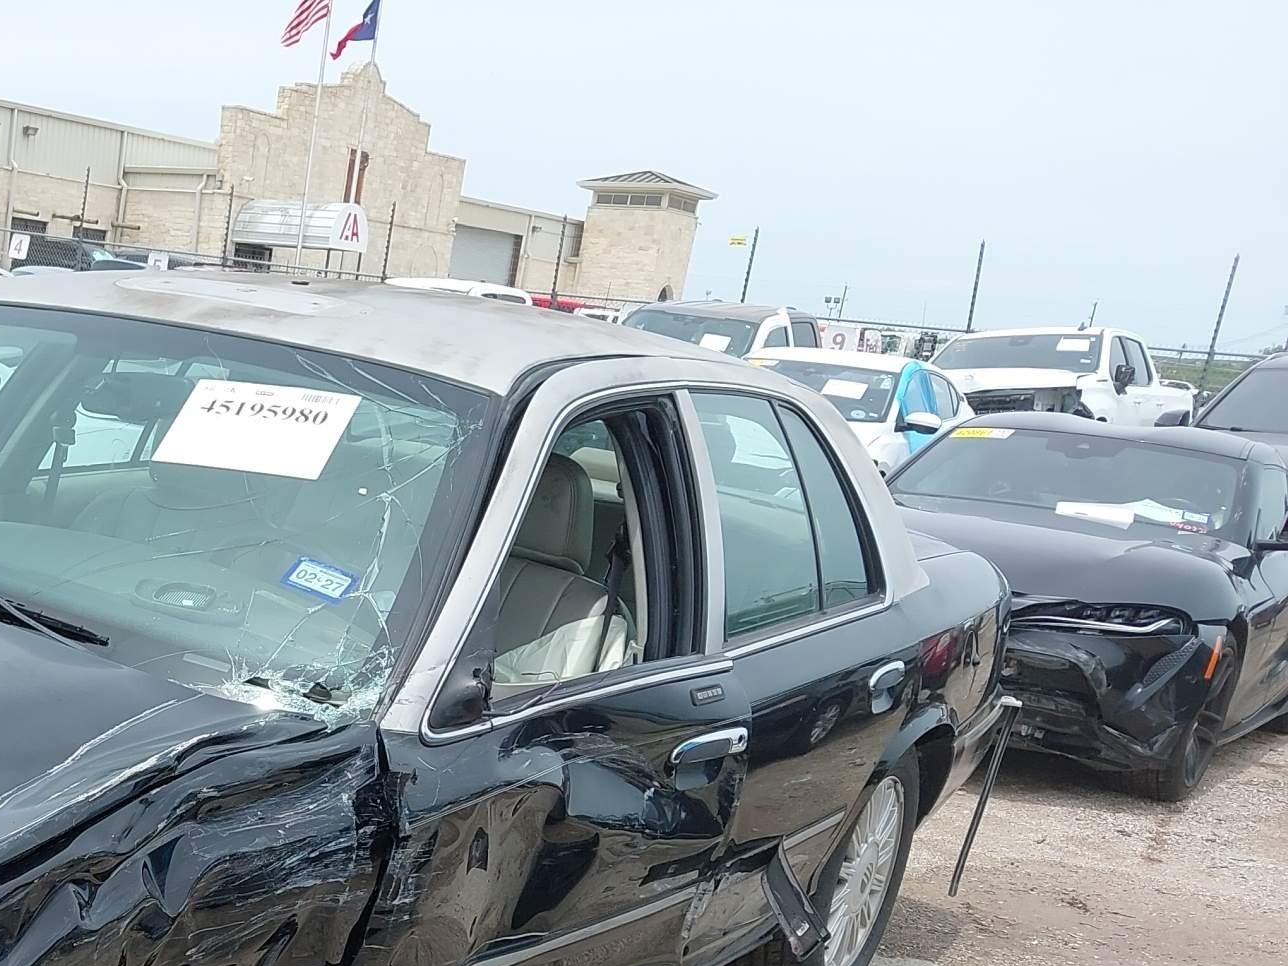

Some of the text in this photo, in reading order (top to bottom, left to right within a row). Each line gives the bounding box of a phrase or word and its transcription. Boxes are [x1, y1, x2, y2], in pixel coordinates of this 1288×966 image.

[14, 238, 24, 255] 4
[200, 398, 329, 426] 45195980
[296, 568, 345, 592] 02 27
